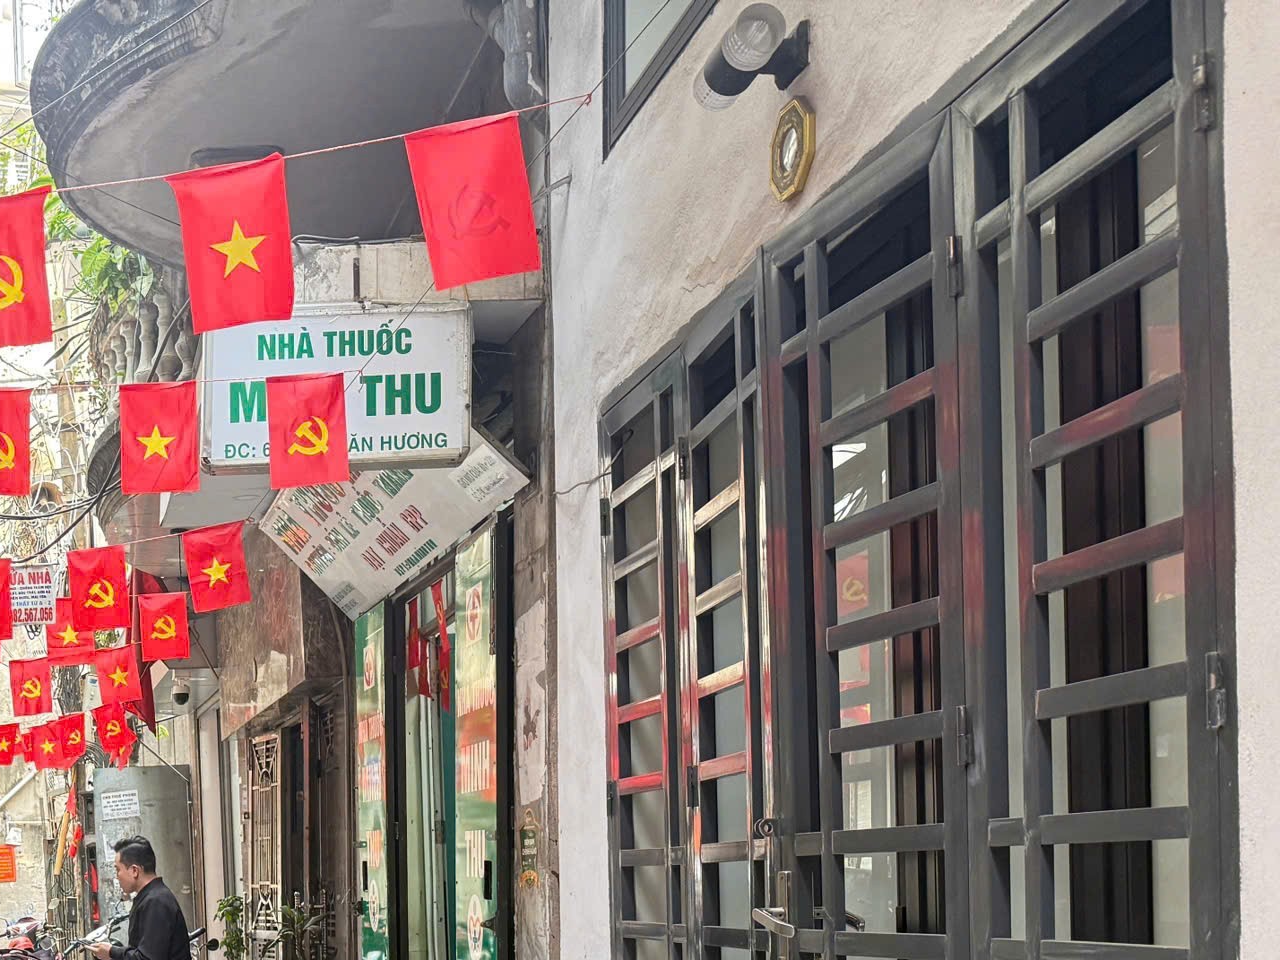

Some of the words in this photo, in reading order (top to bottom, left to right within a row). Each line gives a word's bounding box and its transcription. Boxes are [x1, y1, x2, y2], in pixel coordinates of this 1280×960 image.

[257, 326, 314, 361] NHÀ
[323, 319, 412, 357] THUỐC
[360, 372, 442, 417] THU
[224, 443, 256, 459] ĐC:
[349, 435, 373, 453] ĂN
[380, 432, 448, 451] HƯƠNG
[28, 568, 52, 585] NHÀ
[460, 739, 490, 794] MINH
[464, 830, 486, 878] THU
